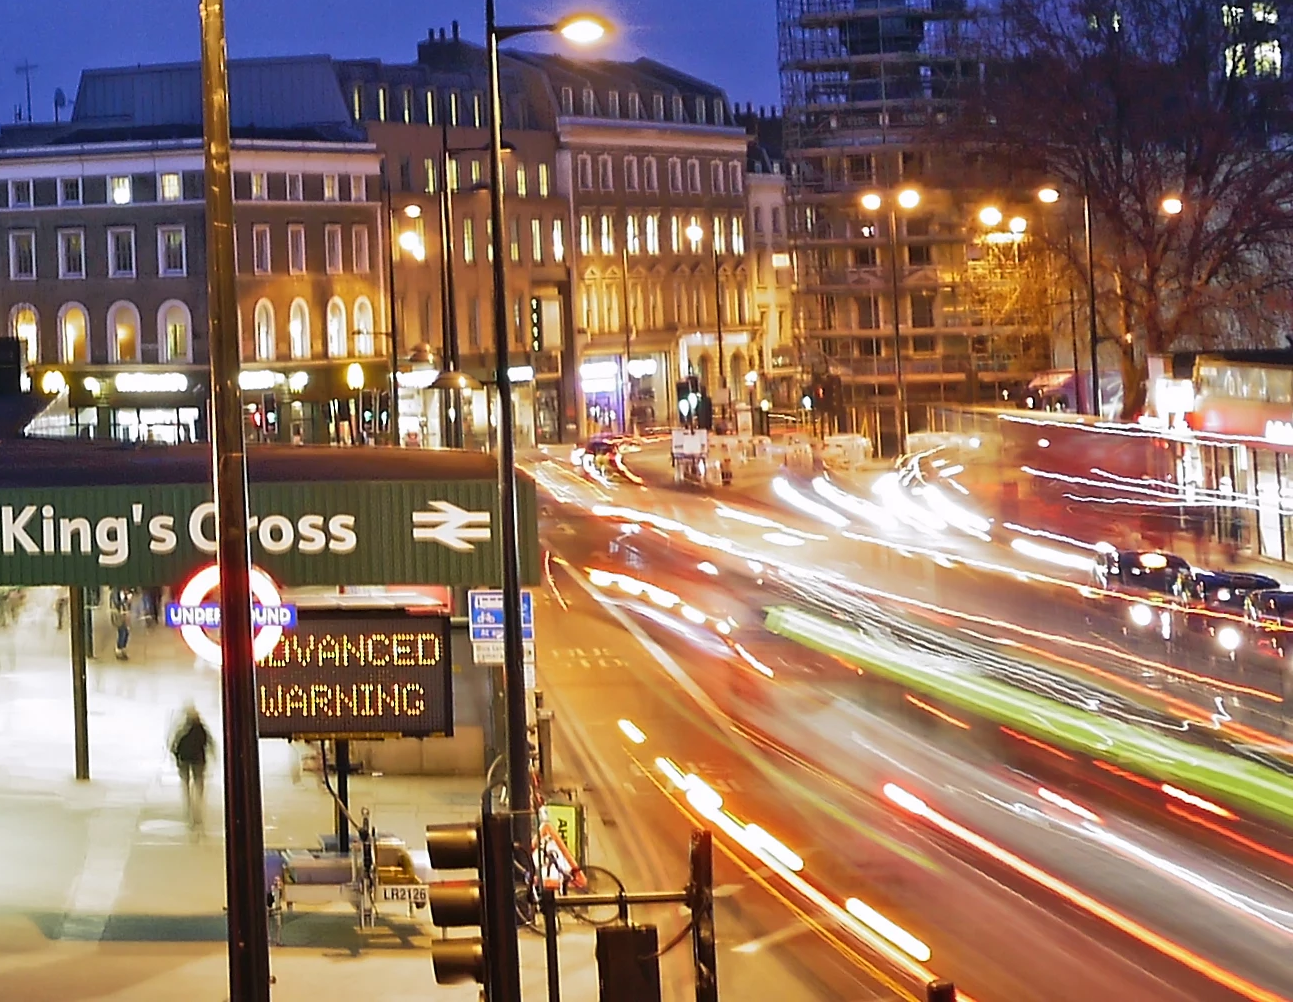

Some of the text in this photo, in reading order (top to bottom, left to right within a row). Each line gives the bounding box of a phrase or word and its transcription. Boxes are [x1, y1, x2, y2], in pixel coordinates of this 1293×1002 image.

[1, 503, 177, 567] King's
[258, 632, 440, 668] DVANCED
[261, 683, 425, 717] WARNING
